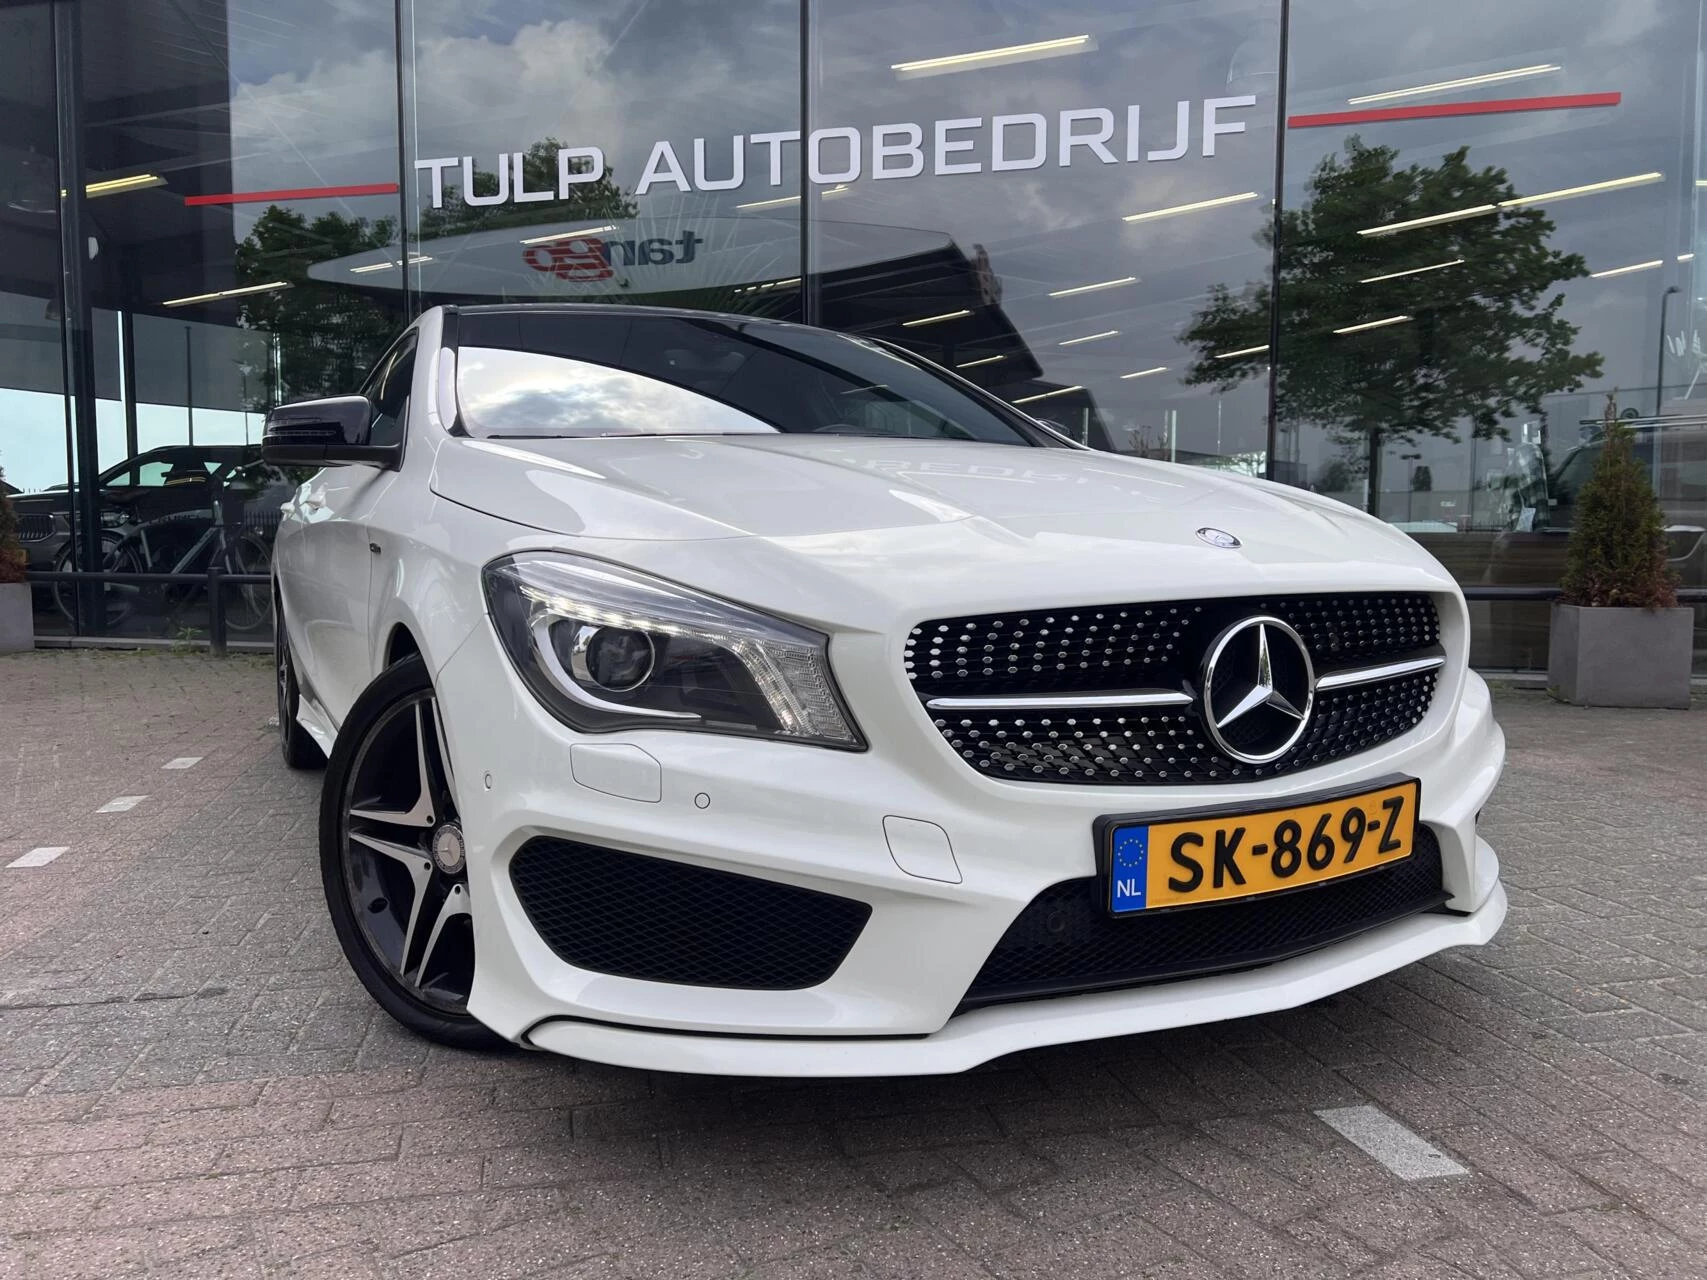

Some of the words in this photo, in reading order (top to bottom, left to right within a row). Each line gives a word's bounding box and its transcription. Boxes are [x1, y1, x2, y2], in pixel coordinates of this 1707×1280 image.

[414, 146, 604, 208] TULP
[634, 95, 1257, 195] AUTOBEDRIJF
[1117, 878, 1141, 898] NL
[1168, 795, 1404, 893] SK-869-Z
